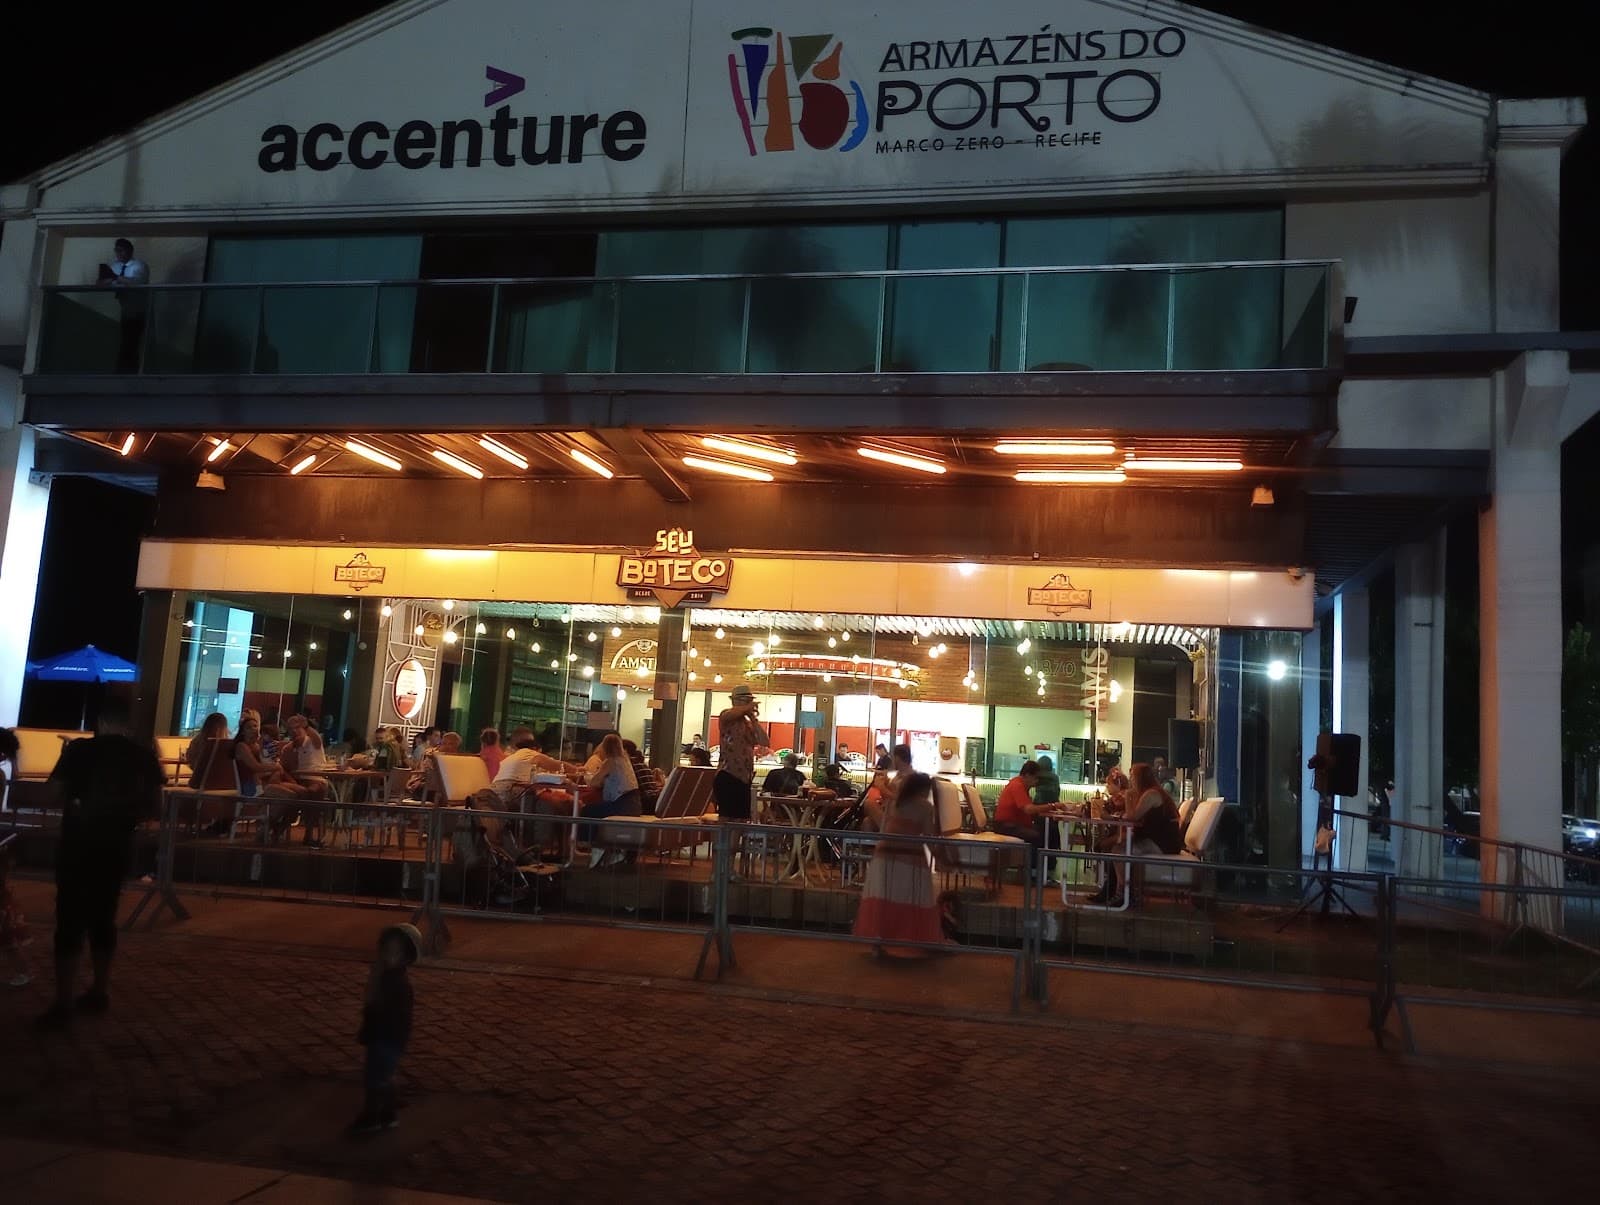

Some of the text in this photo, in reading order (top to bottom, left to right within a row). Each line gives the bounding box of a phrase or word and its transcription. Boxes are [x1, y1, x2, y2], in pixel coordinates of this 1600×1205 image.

[879, 24, 1187, 73] ARMAZÉNS DO
[875, 69, 1162, 132] PORTO
[258, 104, 647, 173] accenture
[875, 138, 945, 154] MARCO
[955, 135, 1005, 151] ZERO
[1035, 131, 1102, 148] RECIFE
[655, 529, 693, 555] SEU
